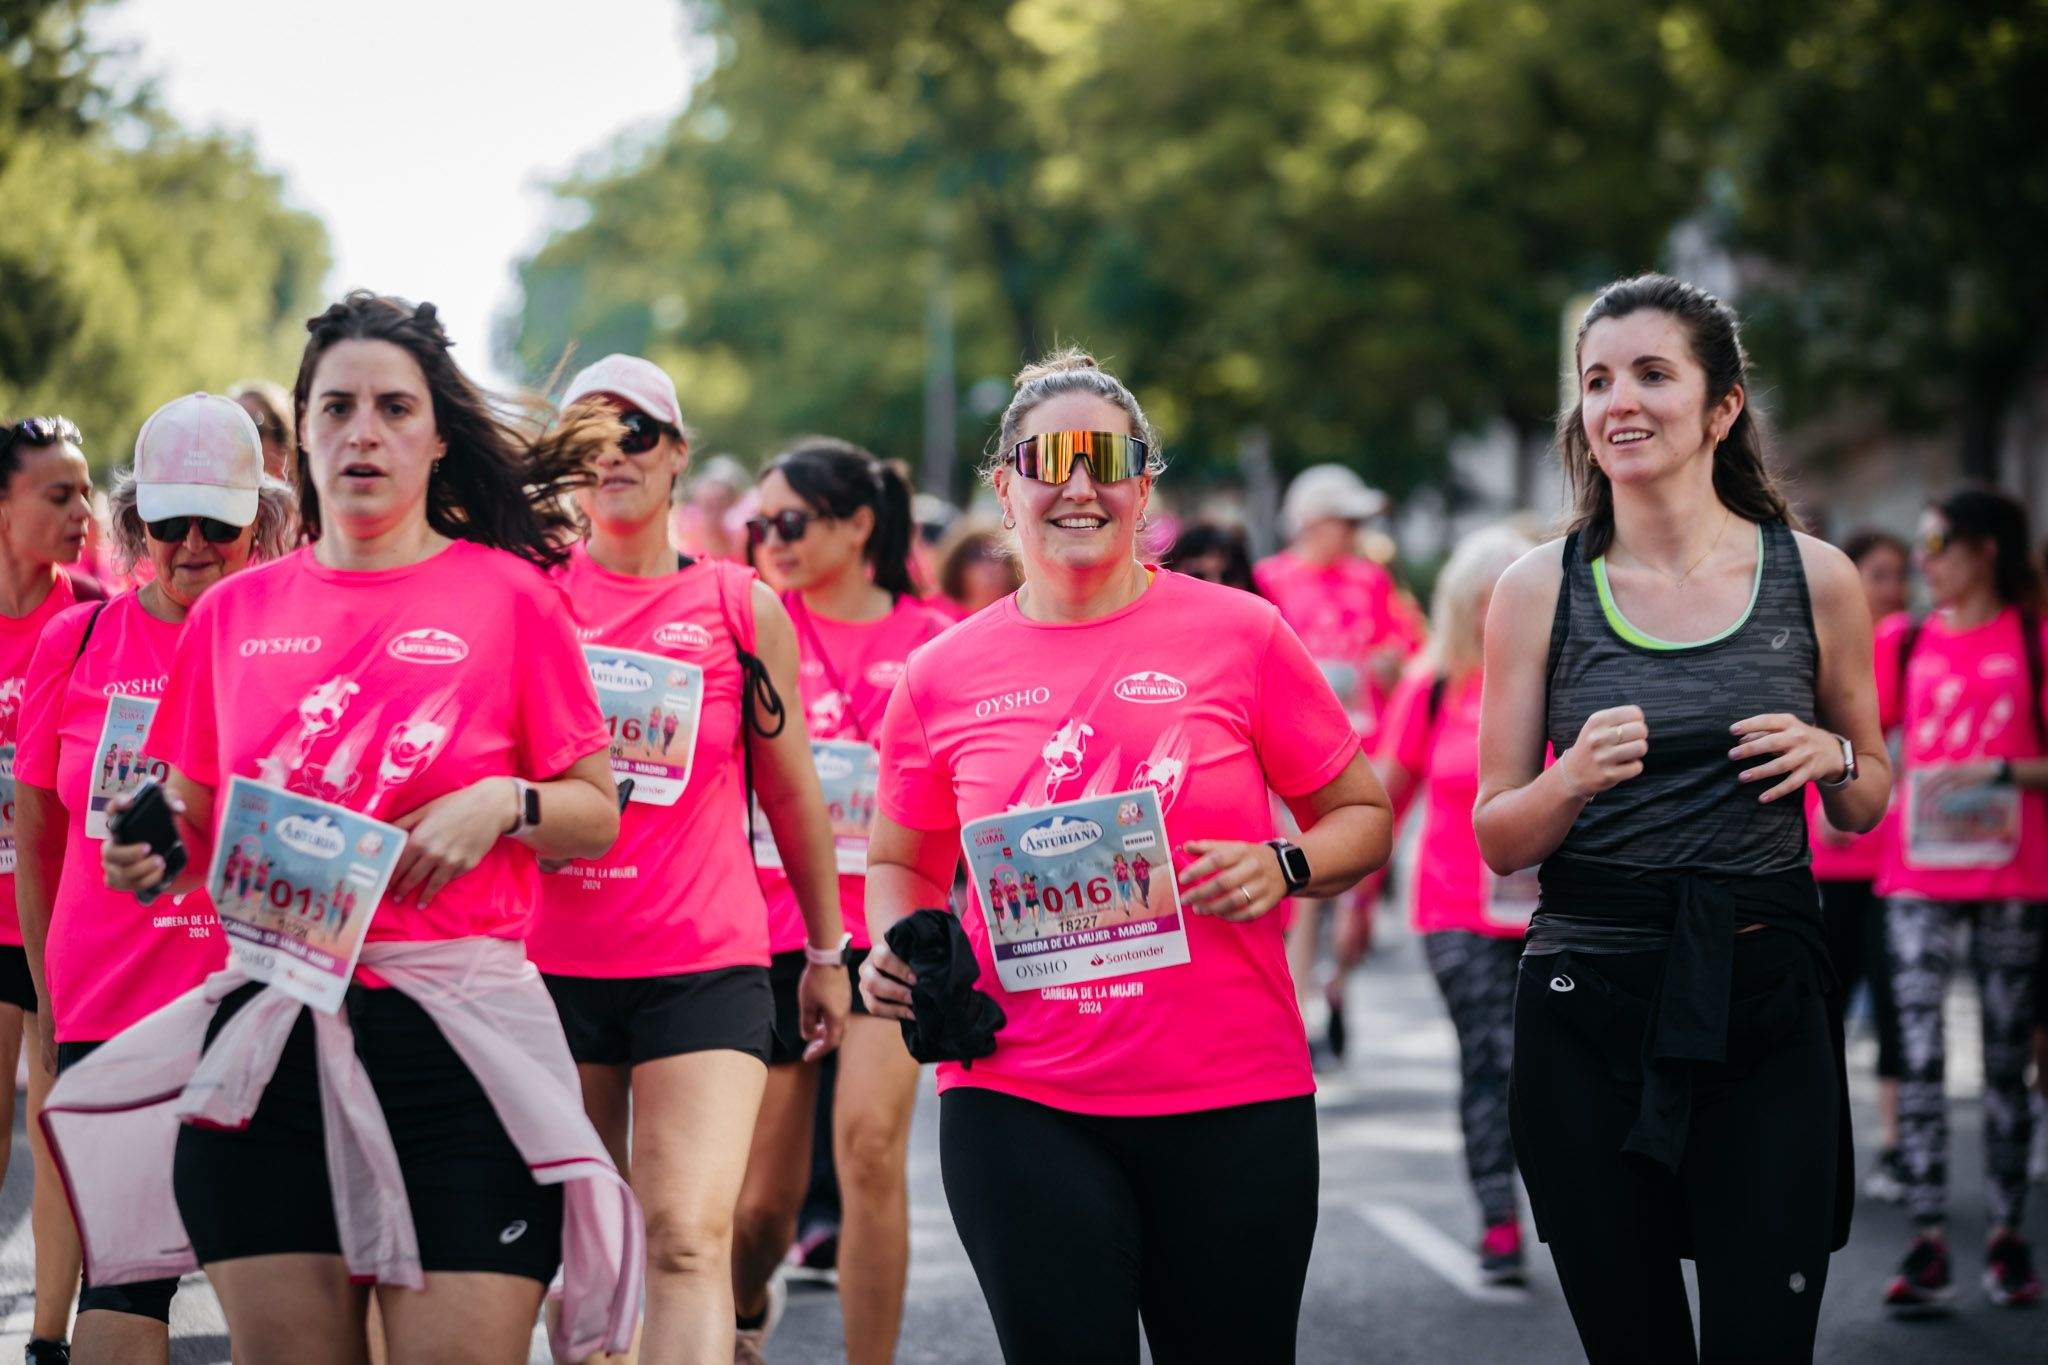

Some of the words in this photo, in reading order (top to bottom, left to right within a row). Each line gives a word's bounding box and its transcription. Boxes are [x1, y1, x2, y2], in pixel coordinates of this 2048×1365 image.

[239, 636, 322, 657] OYSHO
[1120, 682, 1181, 697] ASTURIANA
[975, 686, 1050, 718] OYSHO
[605, 716, 642, 741] 16
[611, 759, 630, 771] UJER
[974, 833, 1005, 848] SUMA
[1026, 828, 1098, 851] ASTURIANA
[598, 867, 608, 879] LA
[609, 865, 638, 879] MUJER
[582, 880, 601, 890] 2024
[1042, 877, 1112, 913] 016
[153, 916, 189, 928] CARRERA
[190, 915, 202, 926] DE
[204, 914, 216, 926] LA
[1059, 915, 1098, 933] 18227
[188, 927, 210, 938] 2024
[1012, 940, 1050, 955] CARRERA
[1050, 938, 1062, 951] DE
[1063, 935, 1077, 948] LA
[1078, 929, 1111, 945] MUJER
[1118, 921, 1158, 938] MADRID
[1105, 945, 1165, 964] Santander
[1016, 959, 1068, 979] OYSHO
[1041, 987, 1079, 1000] CARRERA
[1080, 986, 1093, 1000] DE
[1095, 985, 1107, 999] LA
[1109, 982, 1144, 998] MUJER
[1078, 1001, 1102, 1014] 2024
